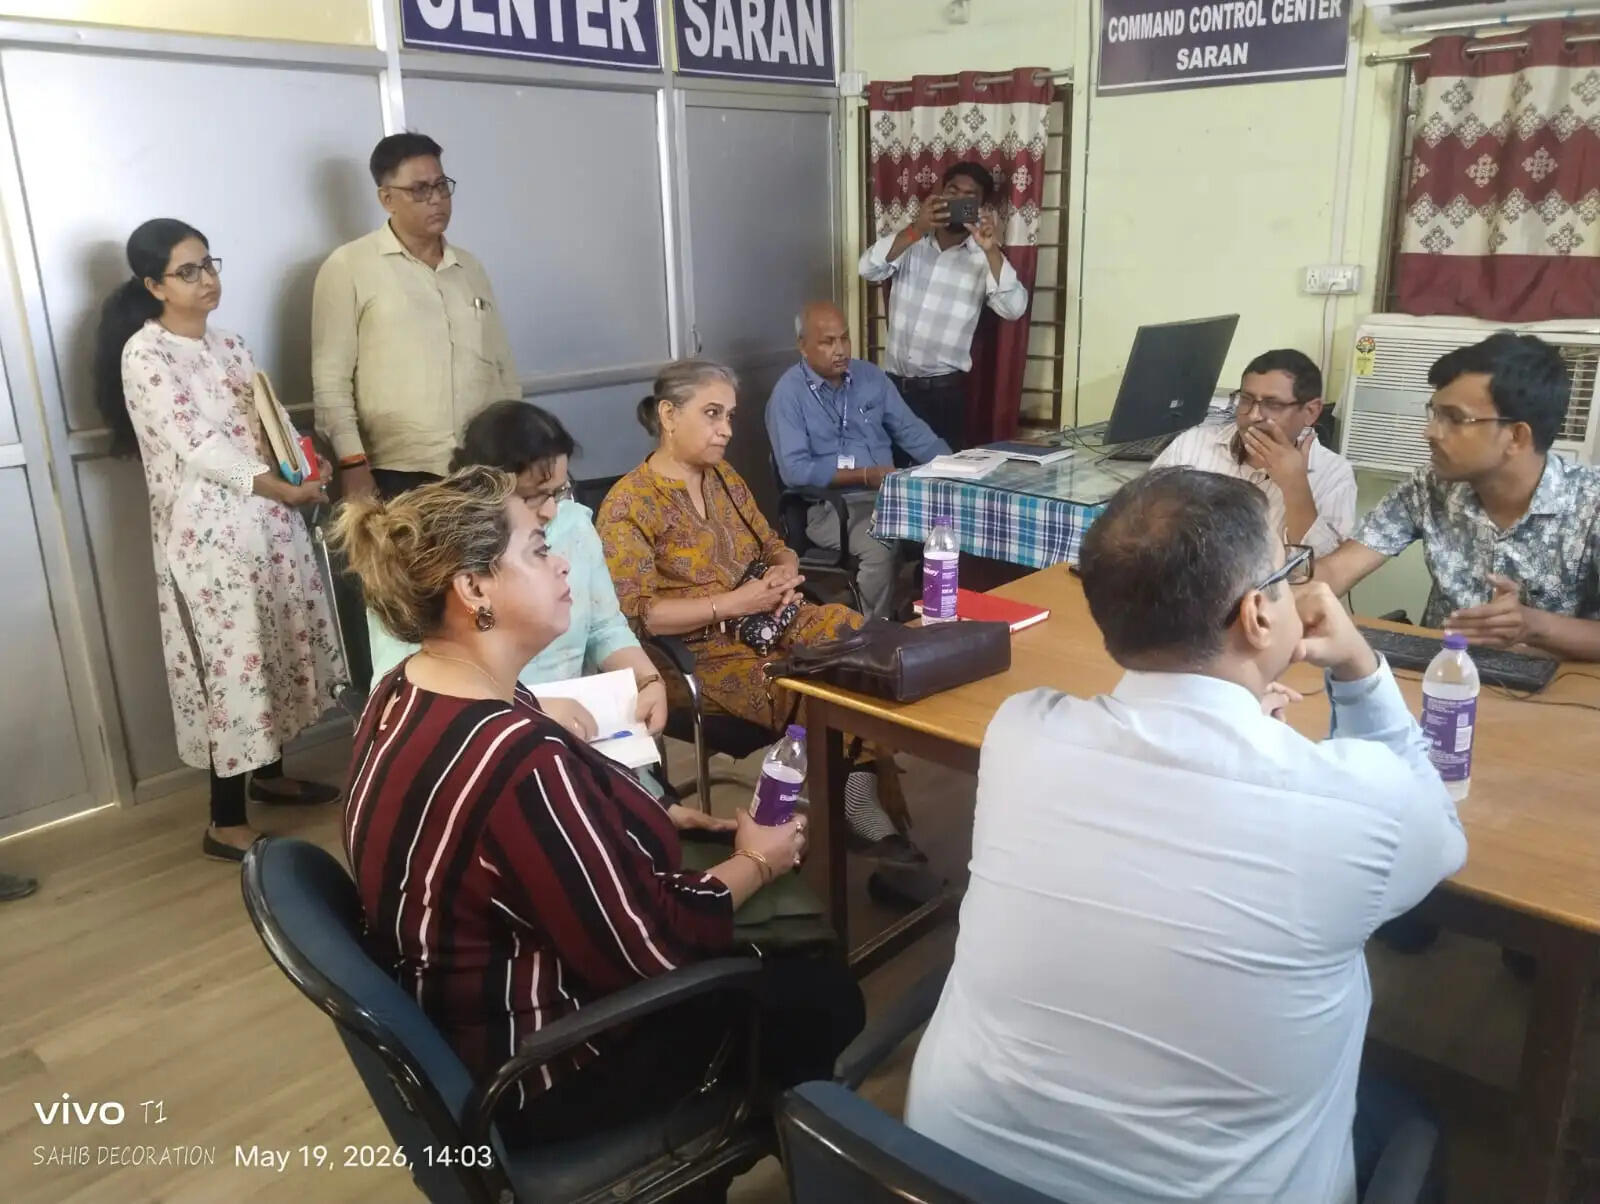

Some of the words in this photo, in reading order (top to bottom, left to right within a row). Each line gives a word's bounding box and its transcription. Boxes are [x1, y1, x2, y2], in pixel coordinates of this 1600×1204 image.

[683, 0, 825, 67] SARAN
[1107, 9, 1185, 43] COMMAND
[1189, 0, 1267, 34] CONTROL
[1271, 0, 1342, 25] CENTER
[1176, 42, 1249, 71] SARAN
